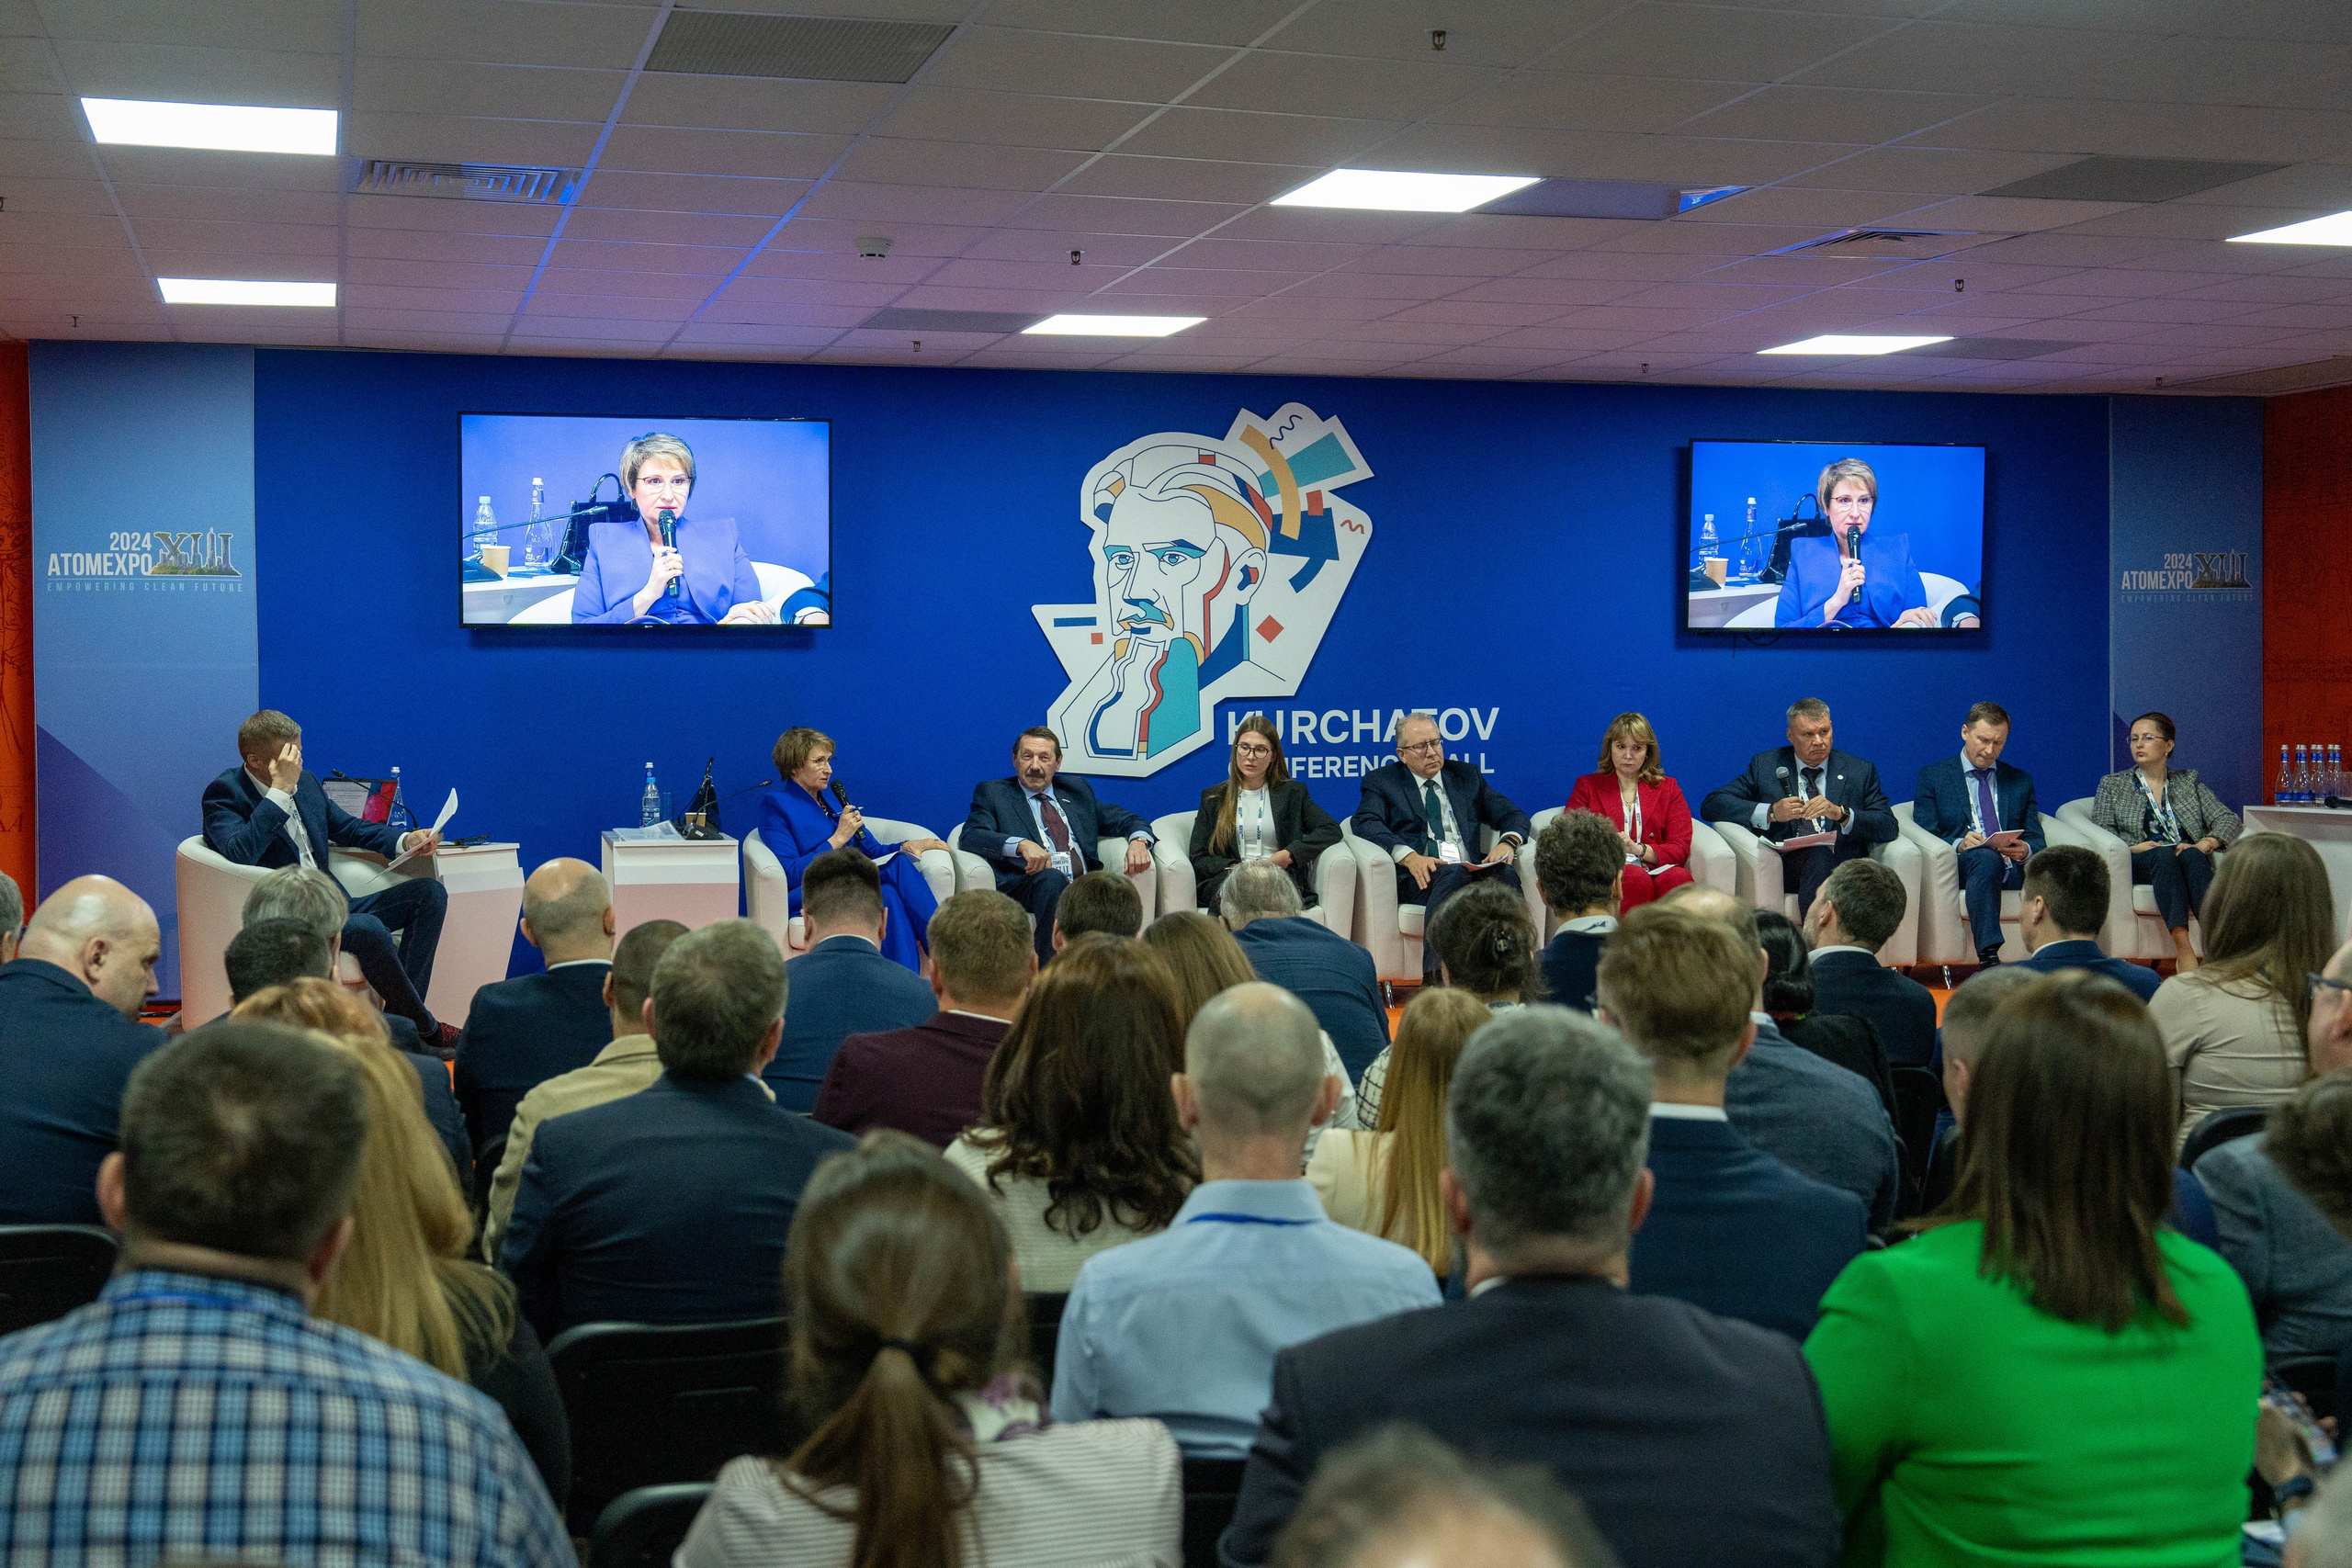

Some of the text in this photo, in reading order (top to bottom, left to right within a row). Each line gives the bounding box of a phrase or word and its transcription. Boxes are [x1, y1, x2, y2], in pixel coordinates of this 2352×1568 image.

[109, 531, 153, 551] 2024
[47, 552, 153, 577] ATOMEXPO
[2164, 553, 2193, 570] 2024
[47, 581, 243, 593] EMPOWERING CLEAN FUTURE
[2121, 570, 2193, 590] ATOMEXPO
[1227, 706, 1500, 746] KURCHAOV
